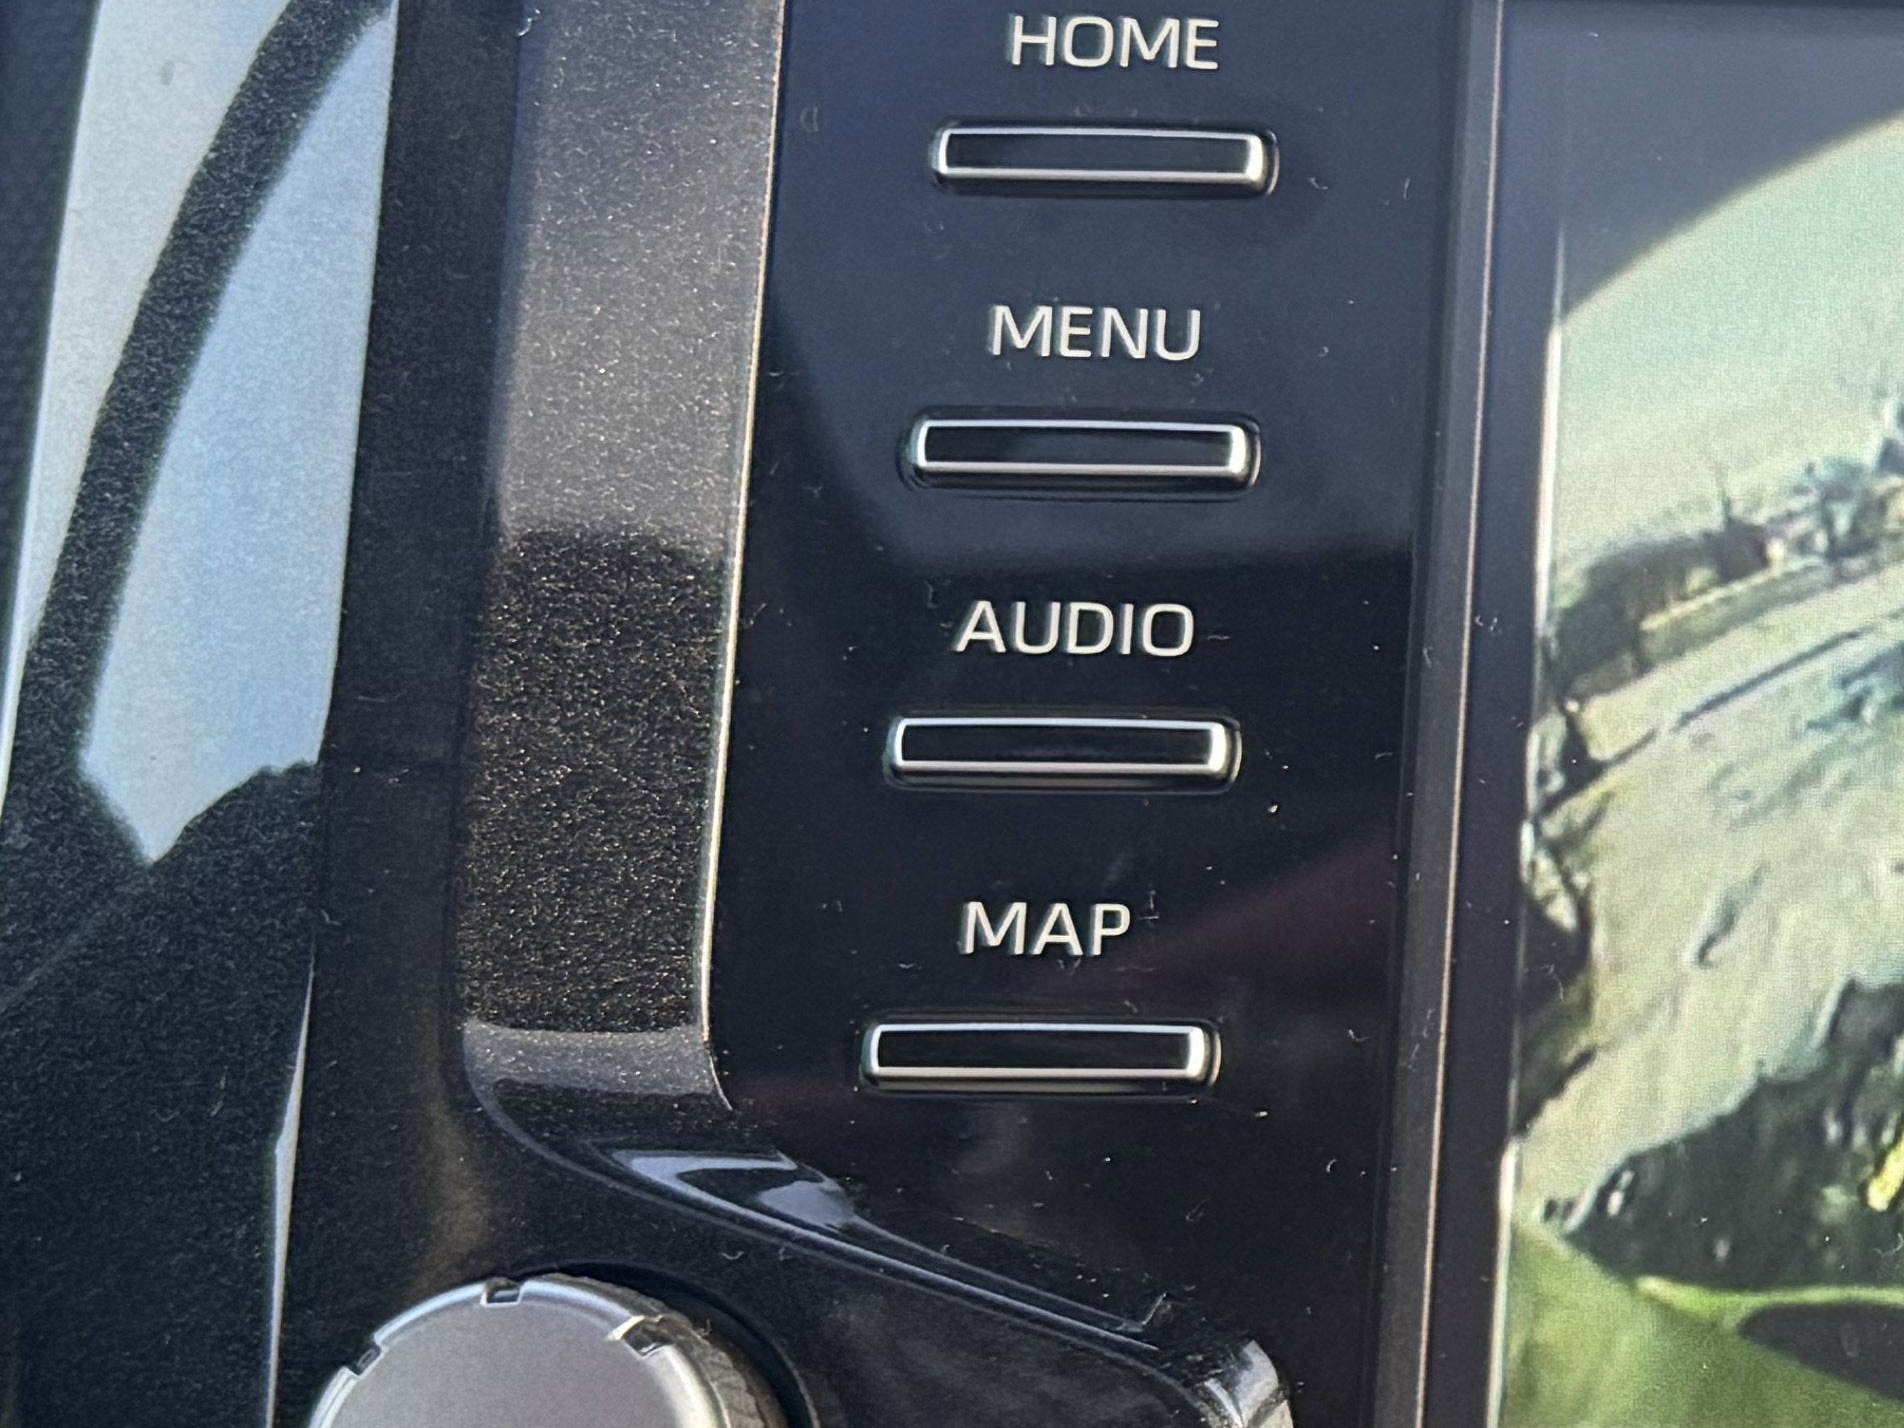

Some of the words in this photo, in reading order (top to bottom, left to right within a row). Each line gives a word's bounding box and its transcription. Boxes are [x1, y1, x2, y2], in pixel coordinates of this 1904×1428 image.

[1010, 14, 1220, 71] HOME
[988, 304, 1203, 362] MENU
[953, 599, 1196, 658] AUDIO
[961, 900, 1132, 958] MAP
